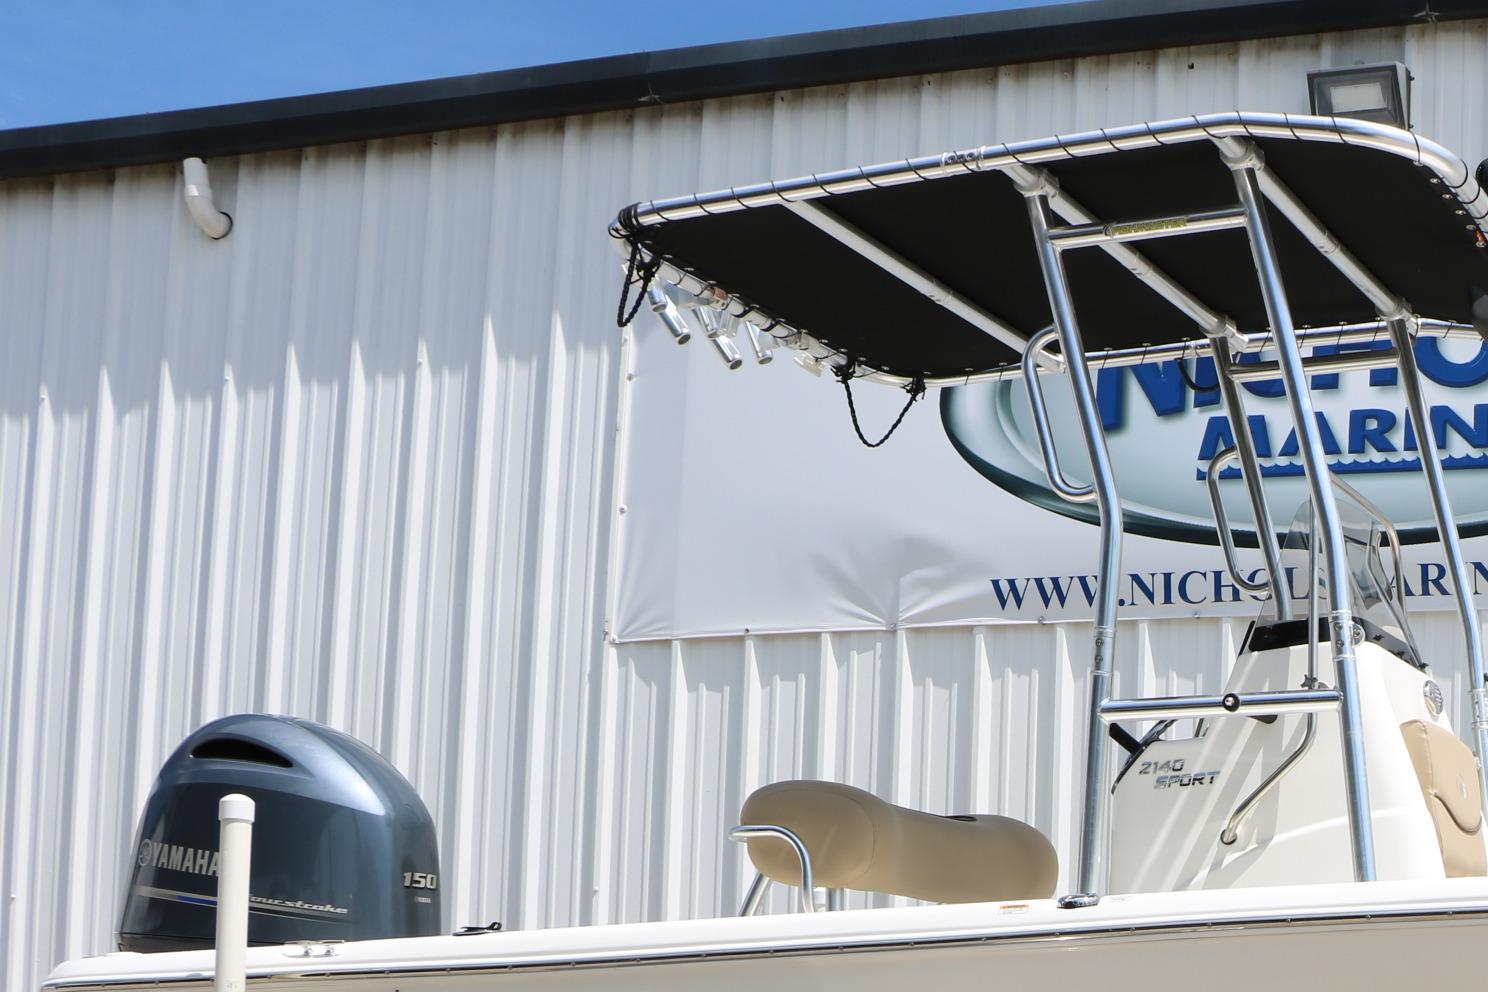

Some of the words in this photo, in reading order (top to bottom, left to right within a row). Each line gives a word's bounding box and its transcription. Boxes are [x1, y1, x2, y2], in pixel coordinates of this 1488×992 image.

[1139, 759, 1184, 775] 2140
[1154, 770, 1220, 789] SPORT
[150, 842, 220, 876] YAMAHA
[403, 872, 437, 889] 150
